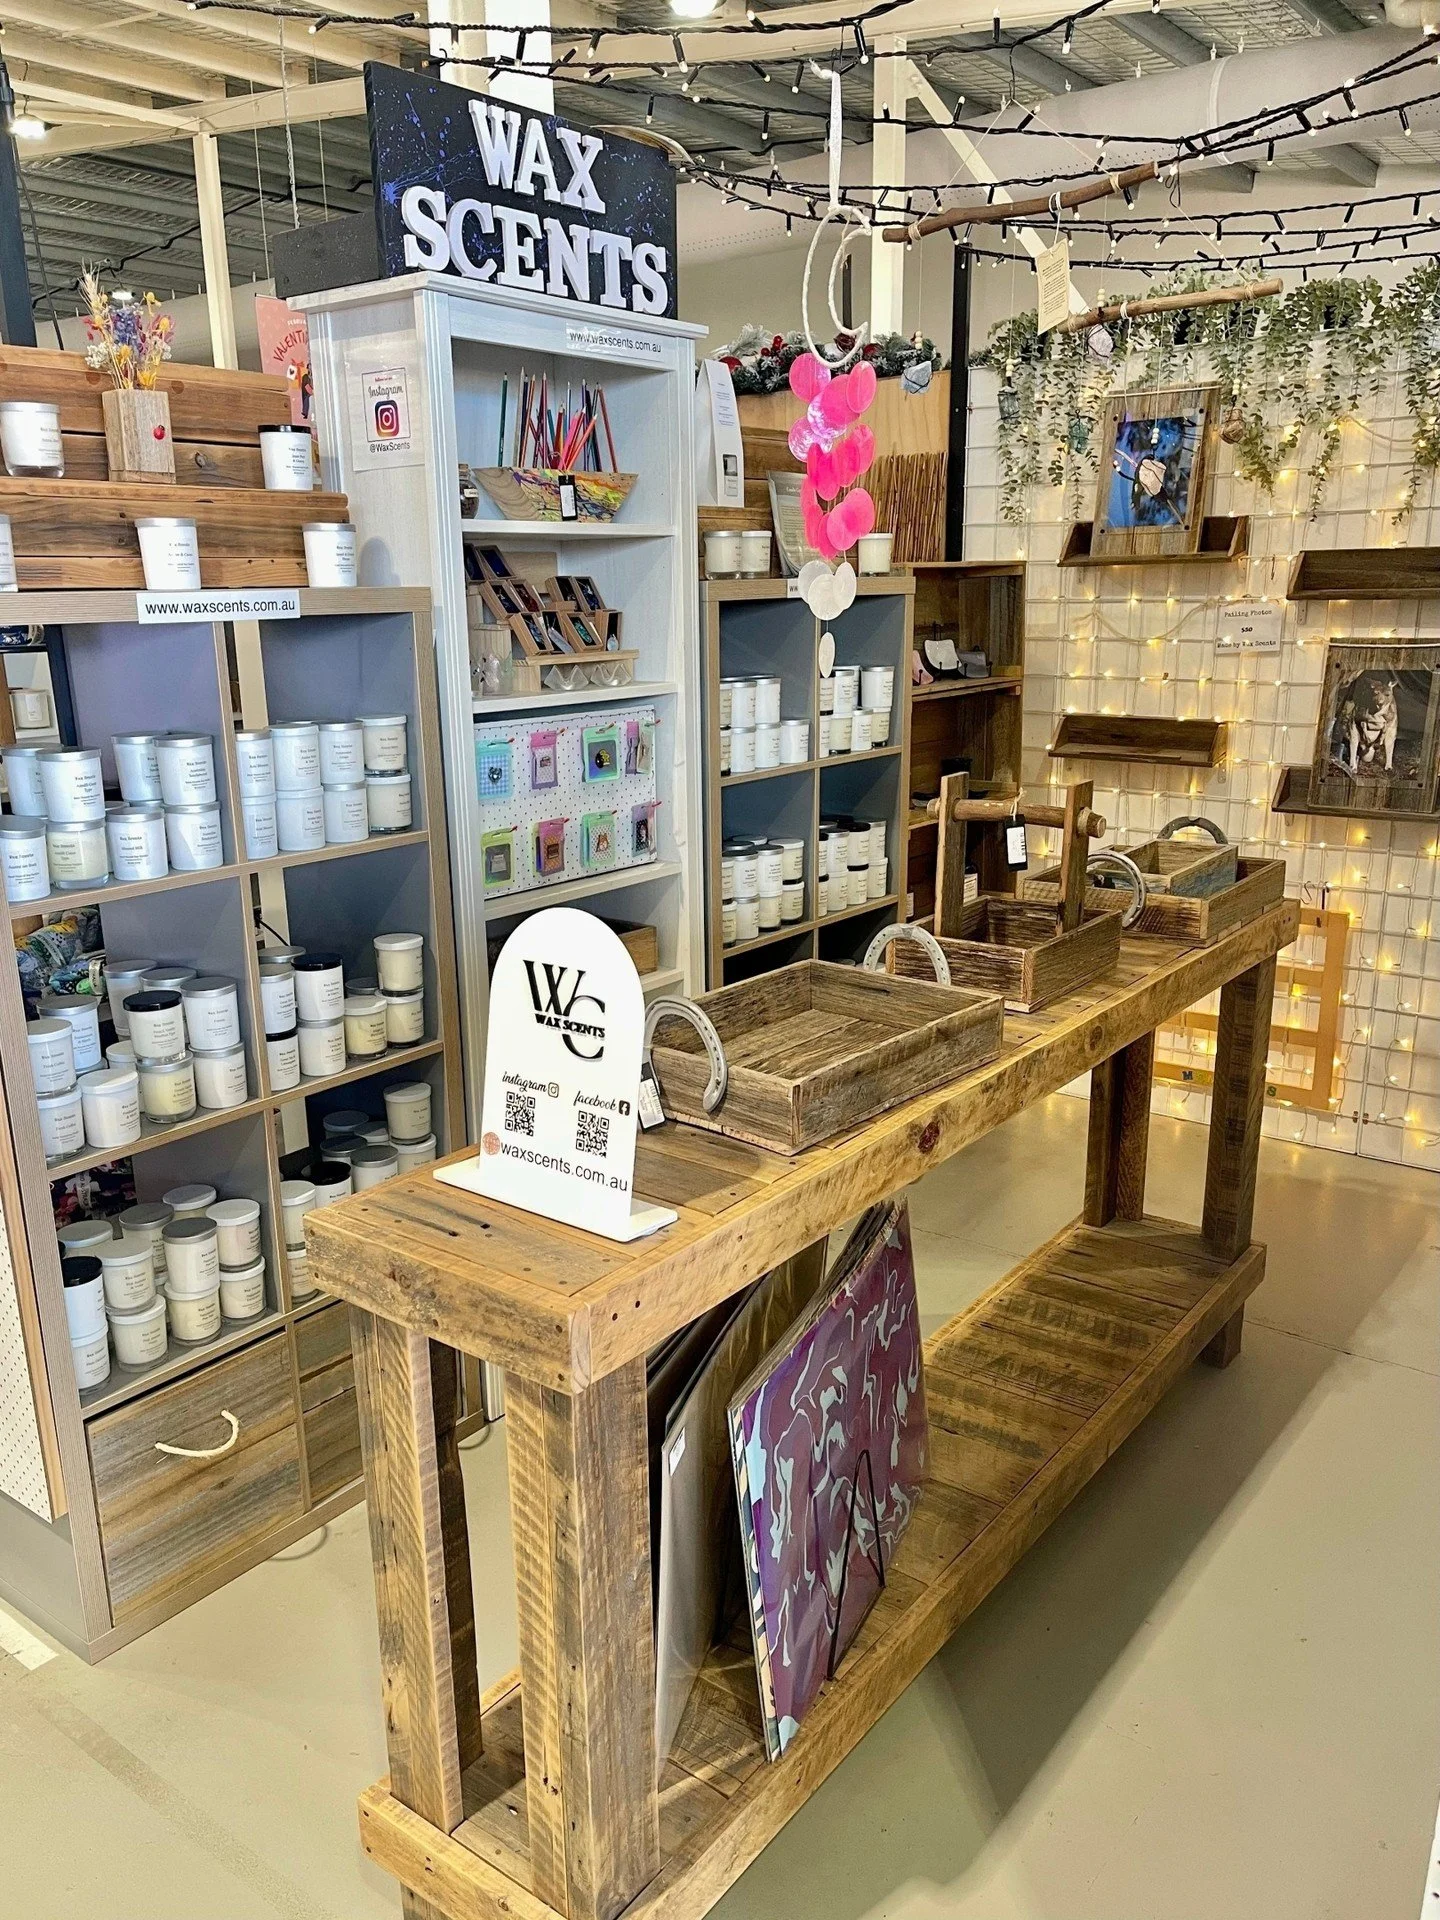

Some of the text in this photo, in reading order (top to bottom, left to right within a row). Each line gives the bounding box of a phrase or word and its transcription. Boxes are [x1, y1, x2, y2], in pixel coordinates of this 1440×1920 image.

[468, 99, 605, 214] WAX
[401, 186, 668, 316] SCENTS
[569, 331, 662, 353] www.waxscents.com.au
[368, 385, 403, 400] Instagram
[369, 441, 411, 453] @WaxScents
[145, 599, 296, 615] www.waxscents.com.au
[534, 1012, 606, 1039] WAX SCENTS
[501, 1070, 548, 1093] instagram
[572, 1089, 618, 1111] facebook
[500, 1141, 629, 1193] waxscents.com.au
